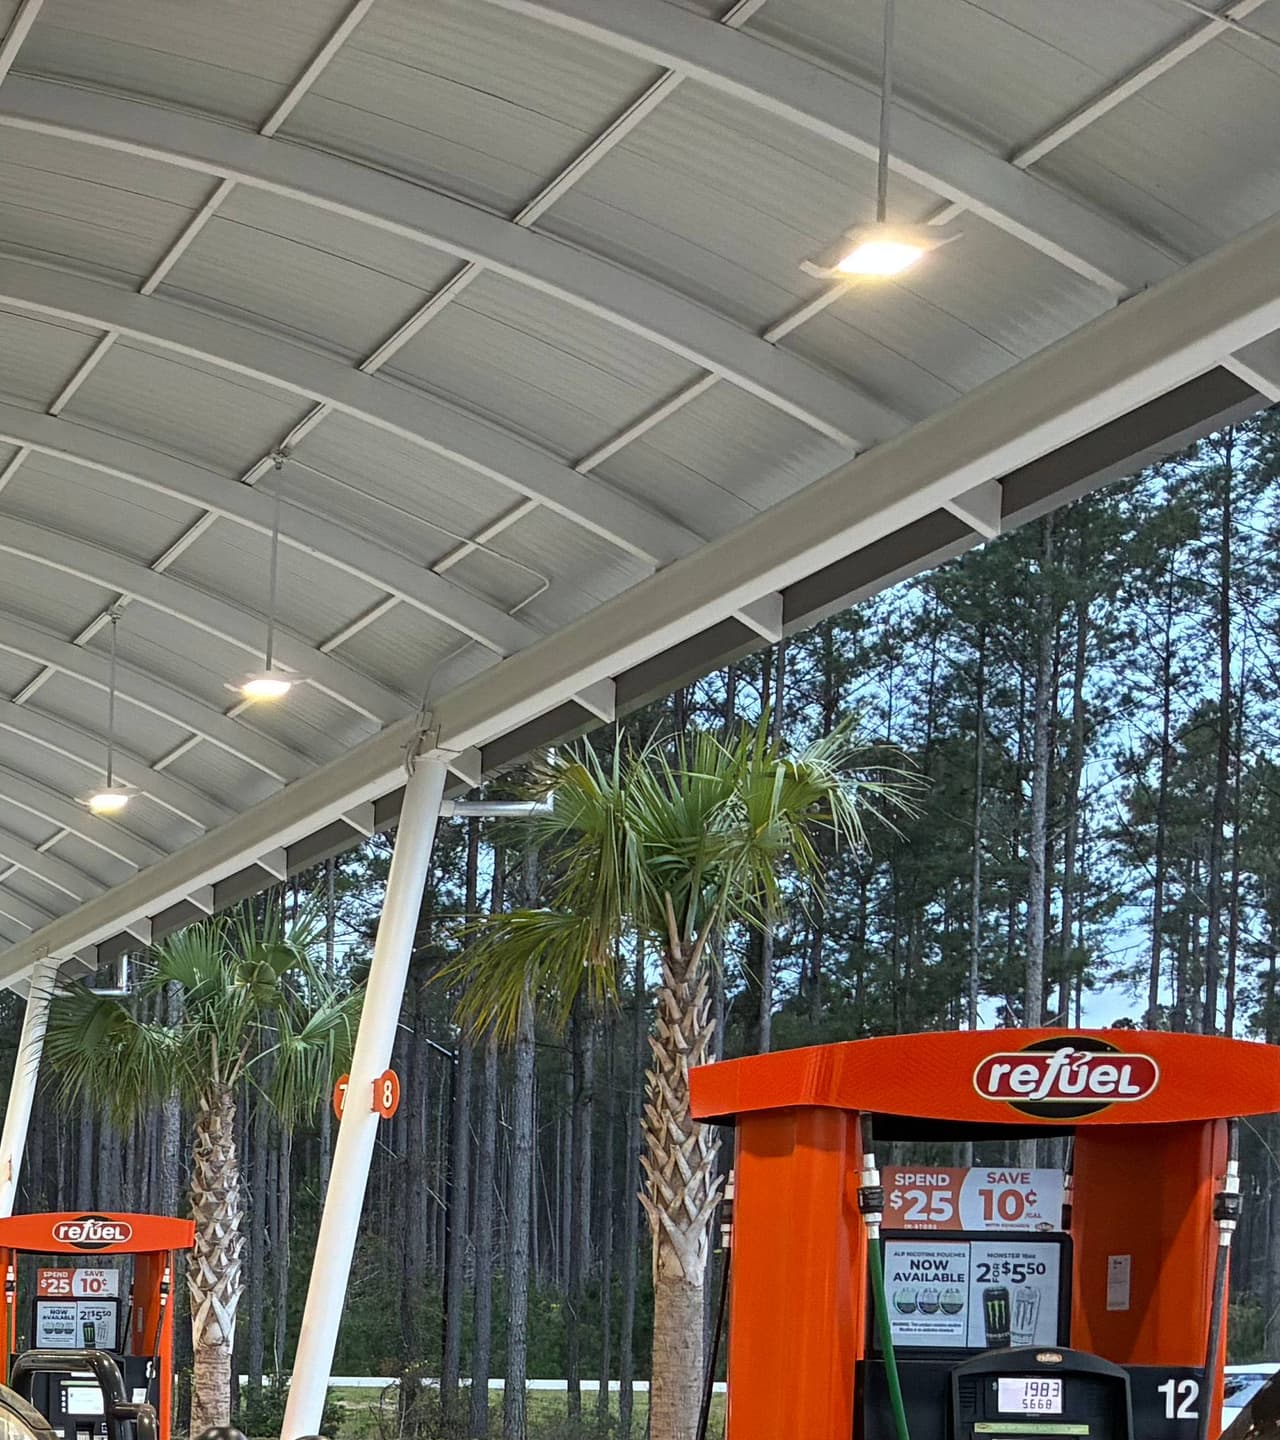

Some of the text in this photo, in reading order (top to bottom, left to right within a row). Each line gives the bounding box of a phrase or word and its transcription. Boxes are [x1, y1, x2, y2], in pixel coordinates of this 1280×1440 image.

[383, 1080, 393, 1108] 8
[895, 1173, 950, 1186] SPEND
[986, 1172, 1030, 1184] SAVE
[890, 1189, 954, 1221] $25
[910, 1259, 949, 1271] NOW
[893, 1272, 965, 1283] AVAILABLE
[976, 1263, 991, 1283] 2
[40, 1279, 70, 1293] $25
[1158, 1379, 1199, 1419] 12
